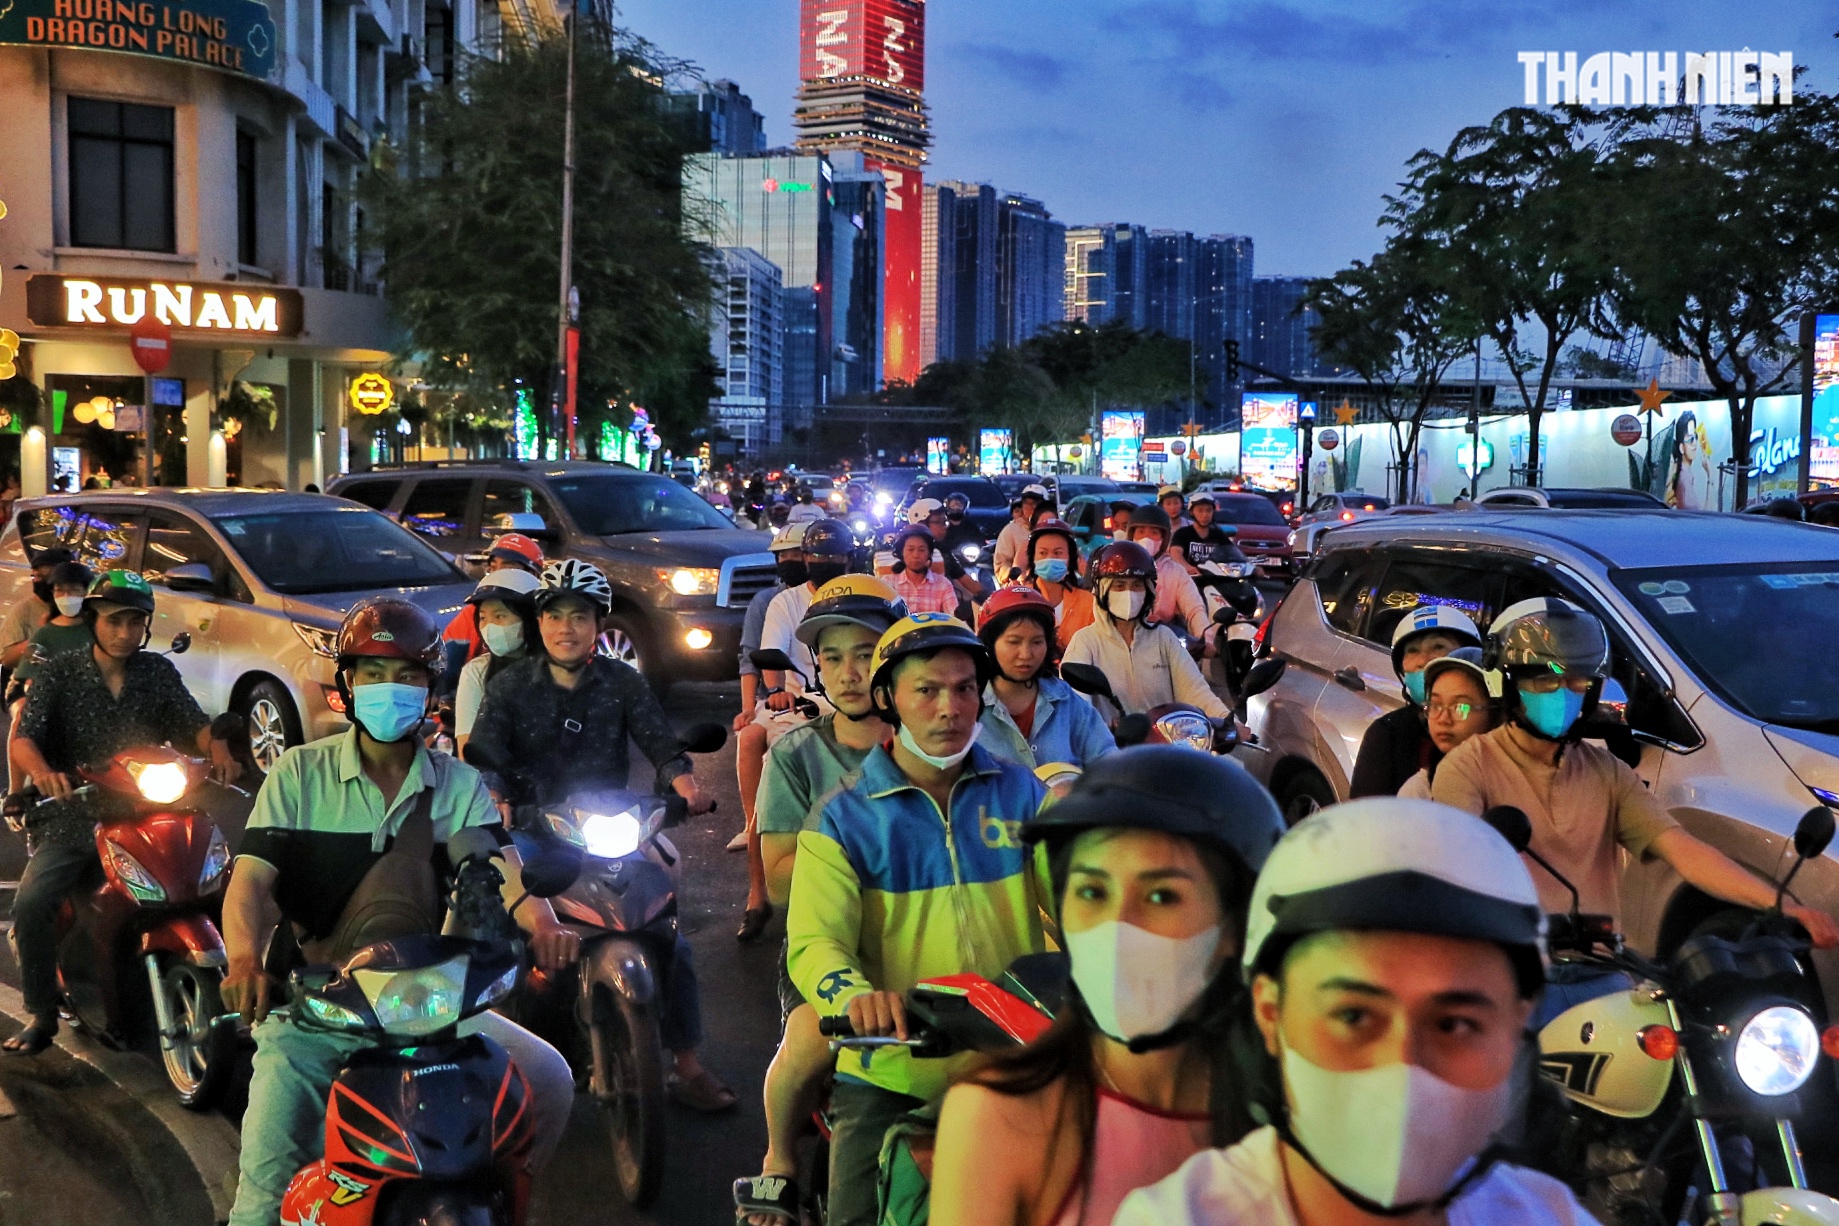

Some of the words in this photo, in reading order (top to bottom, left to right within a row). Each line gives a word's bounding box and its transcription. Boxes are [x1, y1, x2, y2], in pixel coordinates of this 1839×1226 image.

[163, 7, 227, 40] LONG
[27, 16, 148, 50] DRAGON
[156, 30, 245, 71] PALACE
[821, 586, 853, 600] TADA
[413, 1063, 460, 1077] HONDA
[751, 1177, 787, 1200] W
